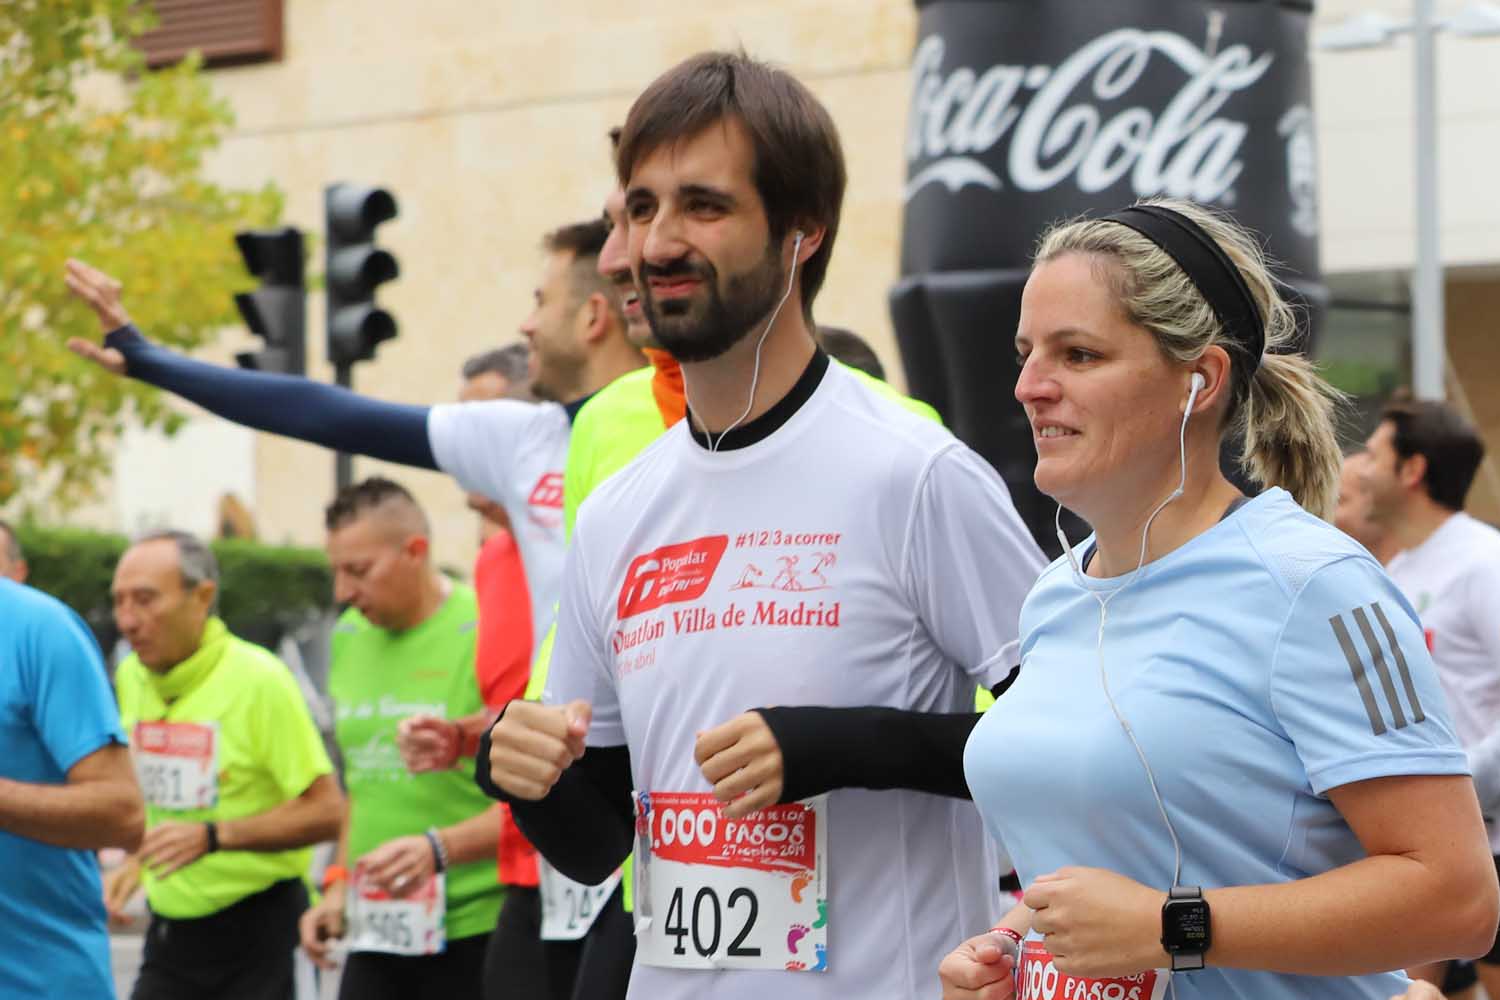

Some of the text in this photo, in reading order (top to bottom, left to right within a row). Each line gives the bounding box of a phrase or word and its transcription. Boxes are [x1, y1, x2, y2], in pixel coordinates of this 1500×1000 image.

[905, 28, 1274, 203] oca-Cola
[673, 607, 716, 635] Villa
[721, 602, 745, 628] de
[751, 600, 840, 627] Madrid
[722, 844, 735, 857] 27
[780, 844, 806, 857] 2019
[725, 822, 805, 846] PASOS
[664, 886, 761, 958] 402
